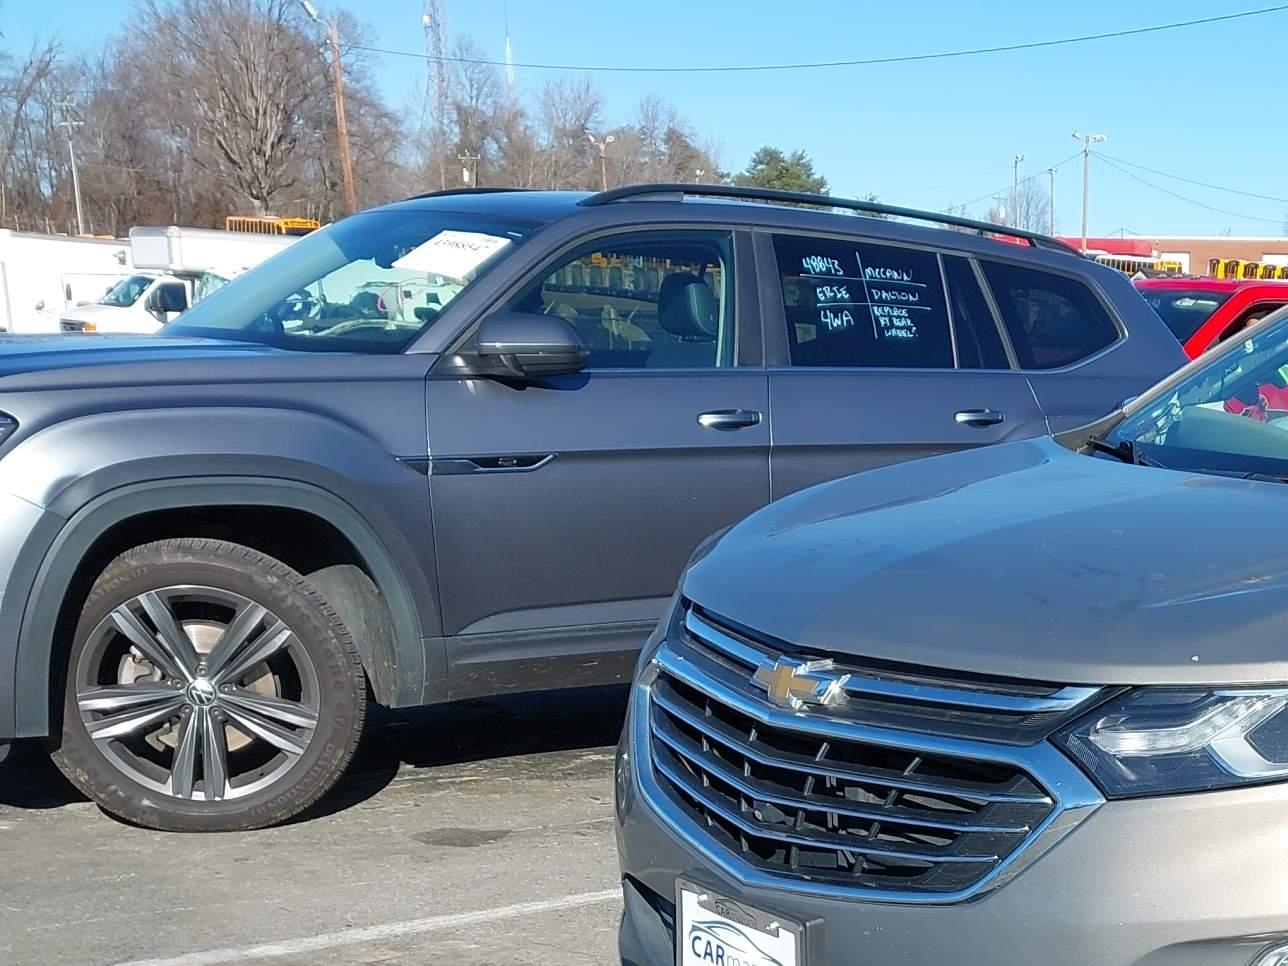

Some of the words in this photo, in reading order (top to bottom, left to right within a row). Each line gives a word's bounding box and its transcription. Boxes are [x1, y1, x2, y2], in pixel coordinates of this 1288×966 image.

[802, 255, 844, 276] 48843
[865, 266, 913, 281] MCCANN
[816, 285, 850, 301] ERIE
[871, 288, 919, 302] DALTON
[820, 310, 854, 330] 4WA
